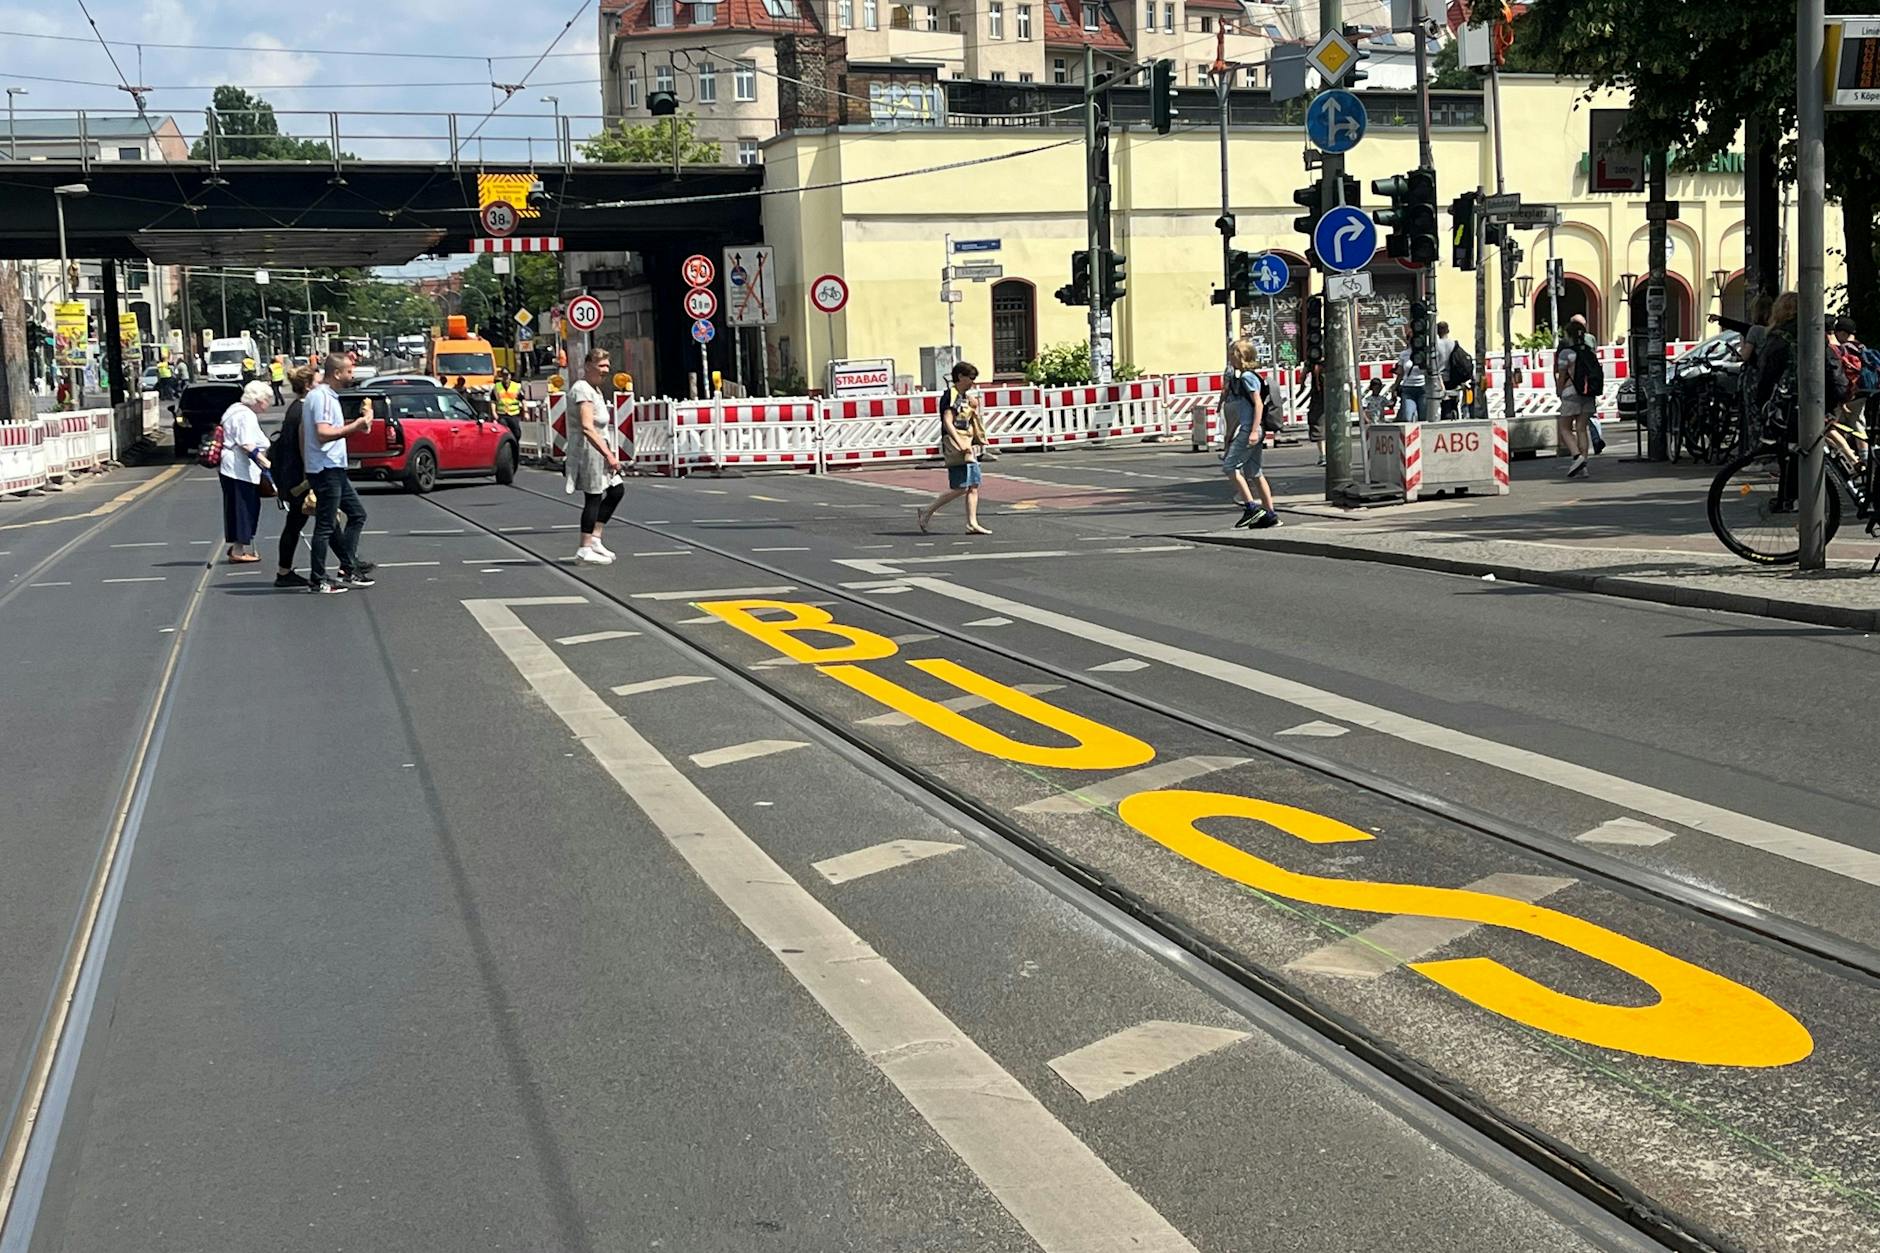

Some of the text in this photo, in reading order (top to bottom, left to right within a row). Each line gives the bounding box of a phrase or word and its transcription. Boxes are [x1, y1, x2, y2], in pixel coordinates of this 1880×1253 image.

[575, 306, 595, 322] 30
[835, 373, 887, 386] STRABAG
[1375, 435, 1394, 455] ABG
[1433, 431, 1479, 454] ABG
[692, 600, 1814, 1068] BUS
